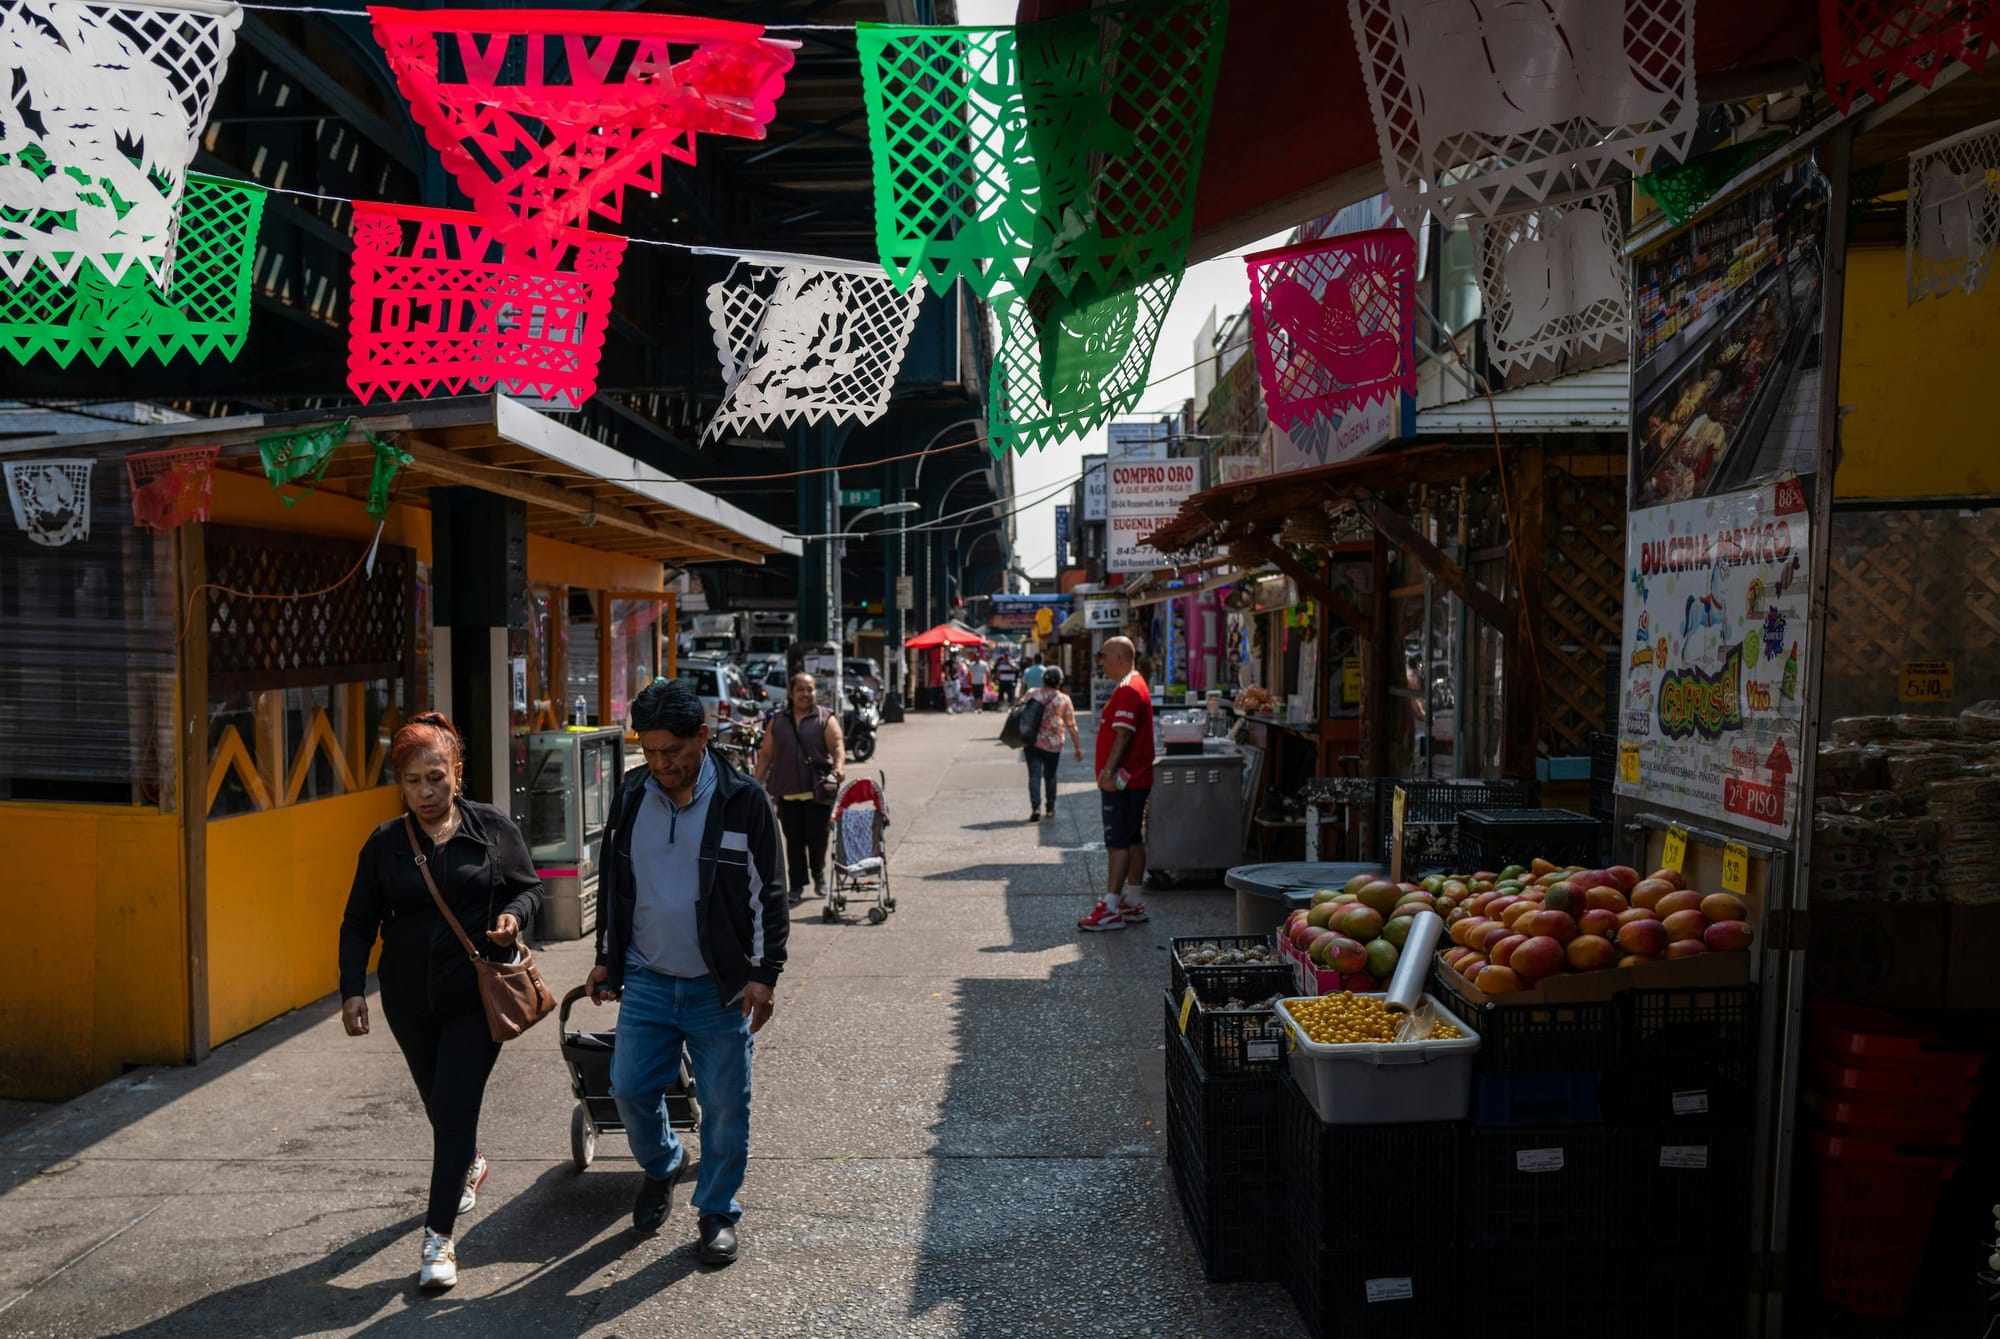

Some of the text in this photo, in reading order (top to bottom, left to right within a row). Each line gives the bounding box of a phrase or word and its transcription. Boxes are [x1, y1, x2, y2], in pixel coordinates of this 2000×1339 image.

[456, 31, 678, 88] VIVA
[1113, 466, 1165, 485] COMPRO
[1167, 465, 1194, 483] ORO
[1113, 518, 1153, 530] EUGENIA
[1641, 520, 1791, 576] DULCERIA MEXICO
[1747, 788, 1778, 818] PISO
